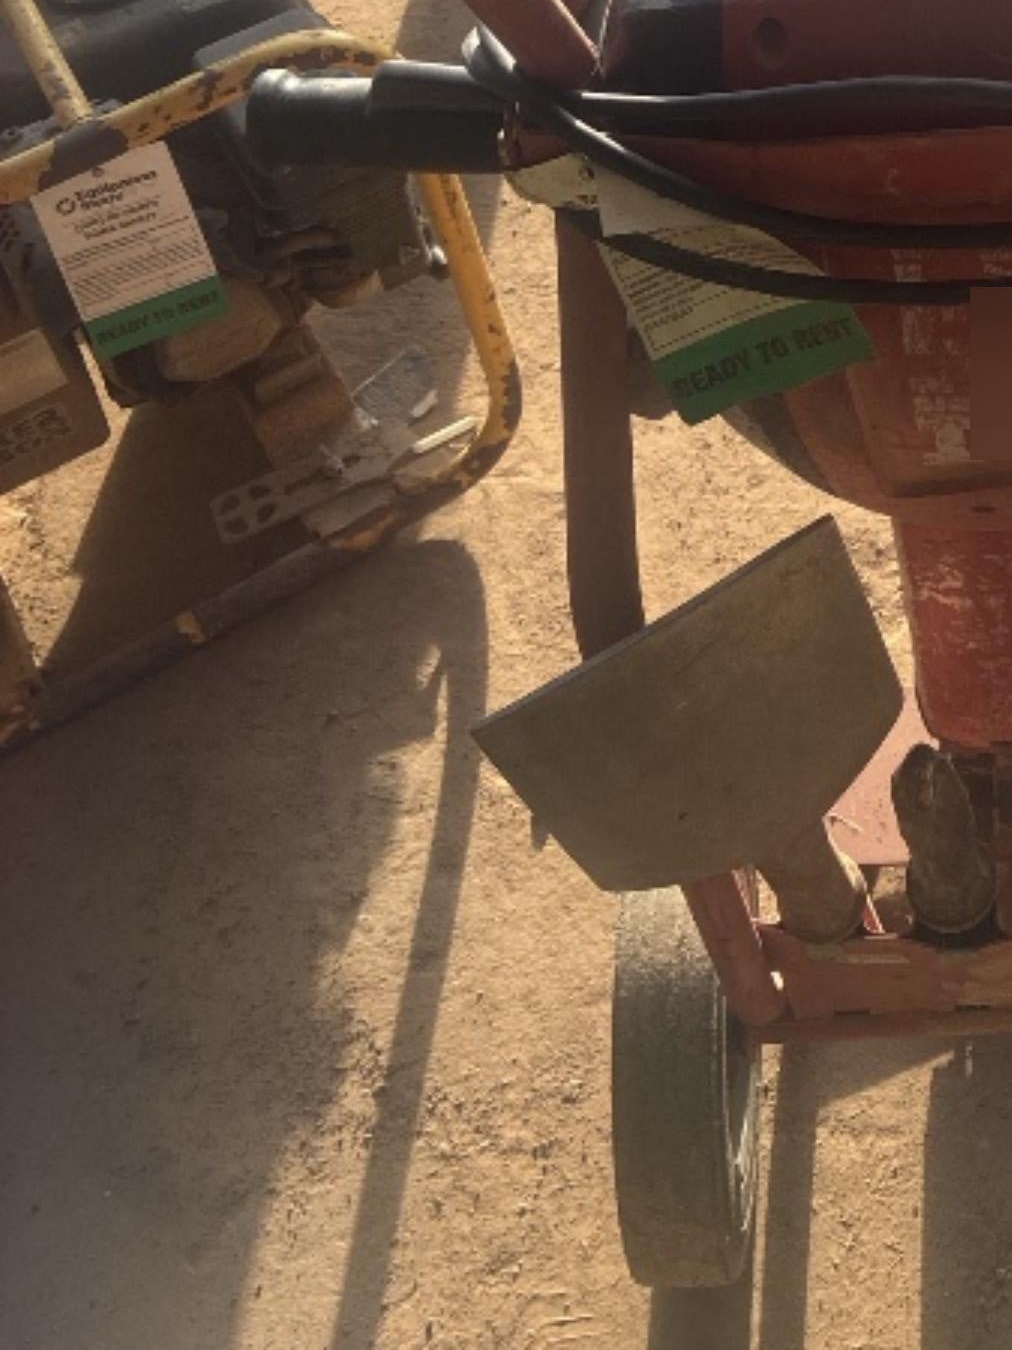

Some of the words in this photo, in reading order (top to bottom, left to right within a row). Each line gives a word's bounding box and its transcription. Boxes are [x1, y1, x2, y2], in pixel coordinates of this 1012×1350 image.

[670, 352, 752, 398] READY
[756, 337, 789, 365] TO
[793, 318, 851, 349] RENT
